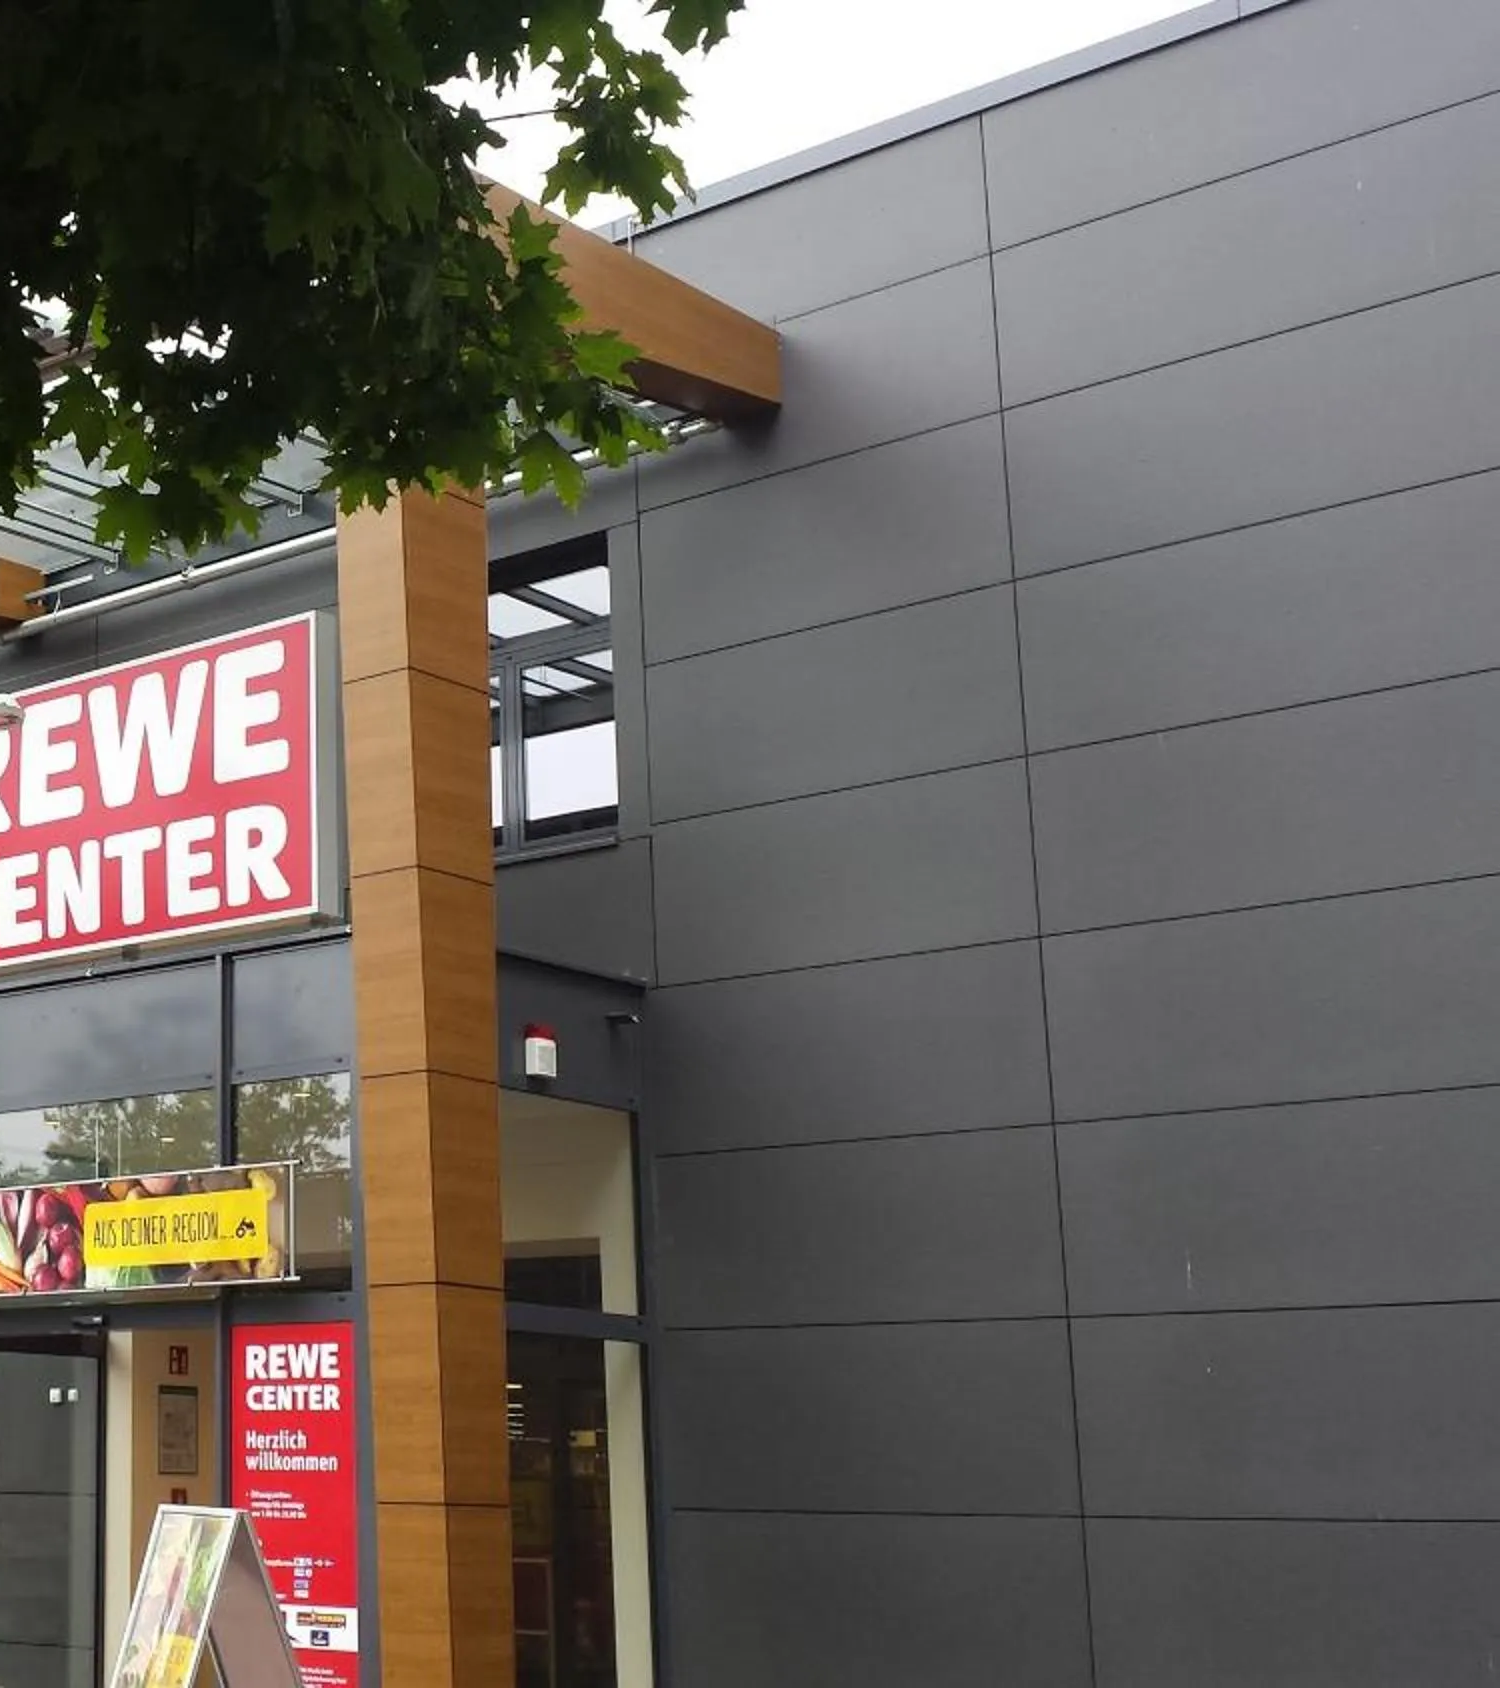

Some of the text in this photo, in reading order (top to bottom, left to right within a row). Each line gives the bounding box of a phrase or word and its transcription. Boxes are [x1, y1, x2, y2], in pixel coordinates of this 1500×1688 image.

[94, 1219, 118, 1249] AUS
[121, 1214, 167, 1247] DEINER
[245, 1343, 341, 1380] REWE
[245, 1384, 341, 1412] CENTER
[245, 1429, 307, 1450] Herzlich
[245, 1451, 339, 1472] willkommen
